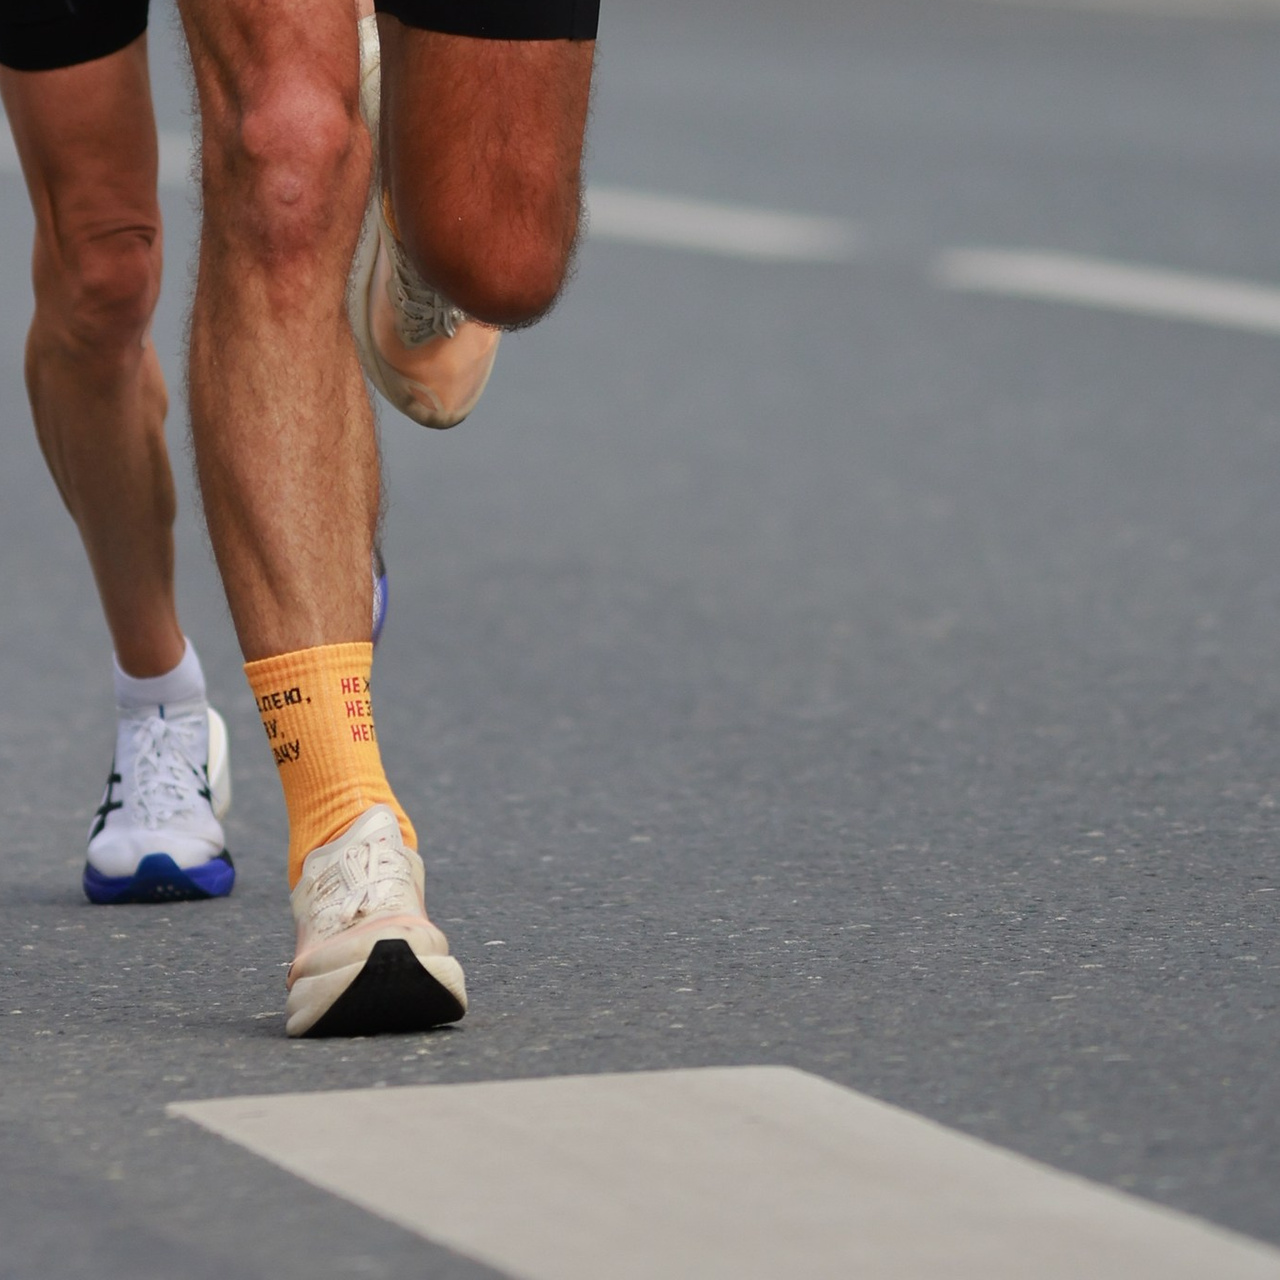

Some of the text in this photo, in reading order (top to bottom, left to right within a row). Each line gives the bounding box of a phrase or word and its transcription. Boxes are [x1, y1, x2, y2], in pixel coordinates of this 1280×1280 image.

[341, 677, 360, 695] НЕ
[345, 700, 365, 718] НЕ
[350, 724, 370, 742] НЕ
